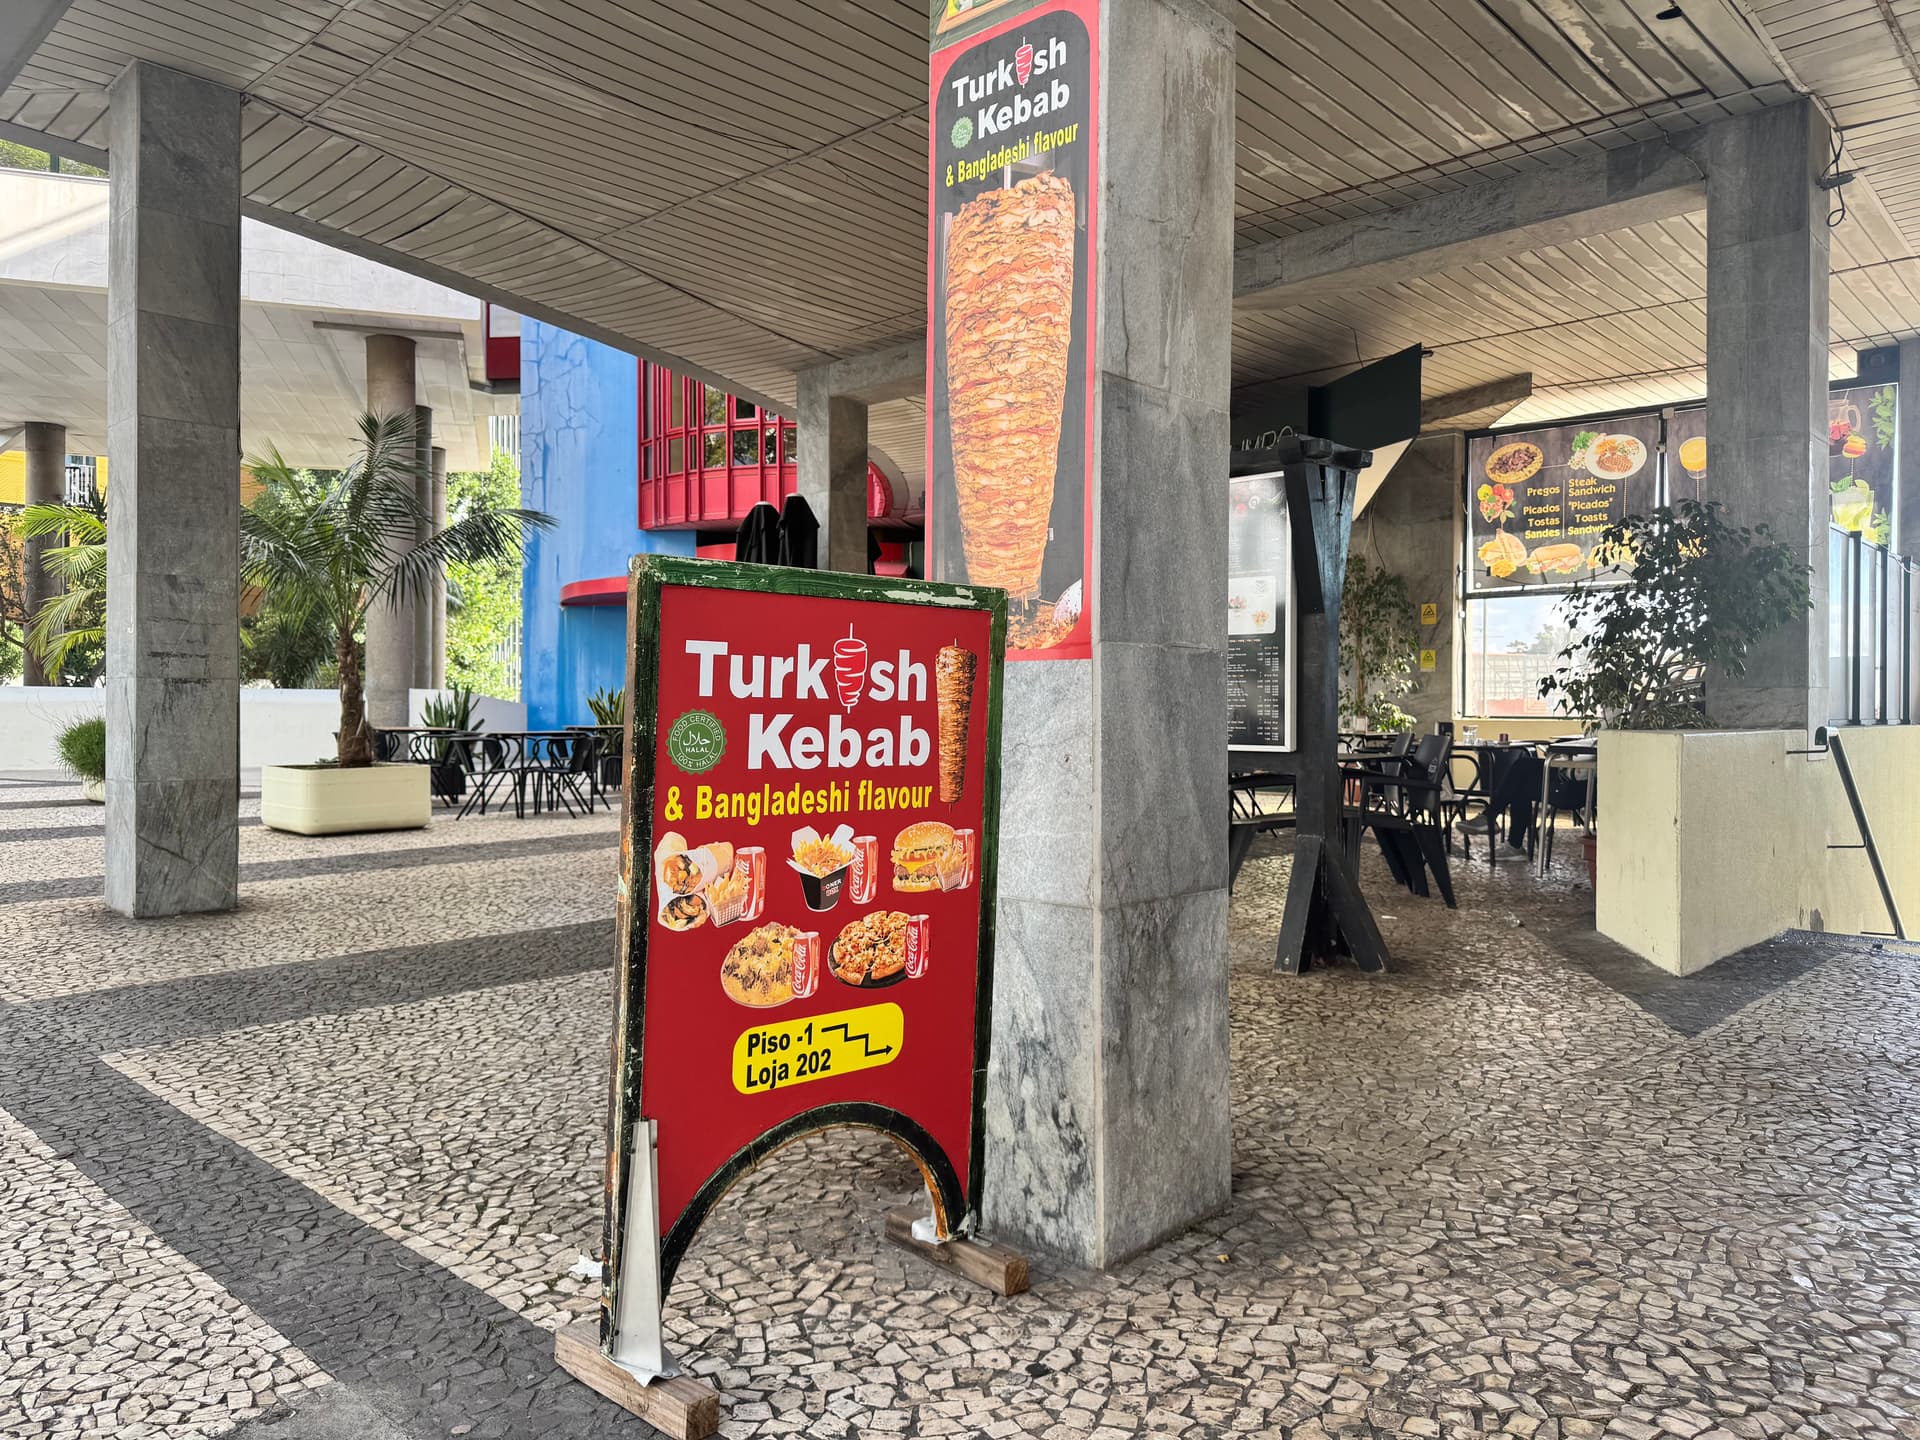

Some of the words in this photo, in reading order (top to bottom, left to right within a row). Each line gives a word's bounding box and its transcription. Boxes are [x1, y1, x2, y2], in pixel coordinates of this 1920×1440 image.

[978, 79, 1070, 139] Kebab
[945, 164, 954, 187] &
[957, 136, 1030, 182] Bangladeshi
[1034, 123, 1079, 155] flavour
[1526, 485, 1560, 497] Pregos
[1568, 477, 1597, 488] Steak
[1568, 484, 1616, 497] Sandwich
[1523, 504, 1560, 515] Picados
[1575, 512, 1608, 523] Toasts
[1527, 517, 1560, 527] Tostas
[1524, 529, 1561, 540] Sandes
[672, 720, 688, 741] FOOD
[690, 715, 721, 741] CERTIFIED
[747, 713, 931, 770] Kebab
[677, 752, 694, 768] 100%
[696, 751, 718, 768] HALAL
[664, 785, 684, 821] &
[695, 780, 850, 826] Bangladeshi
[858, 780, 933, 811] flavour
[747, 1031, 791, 1057] Piso
[797, 1022, 813, 1045] -1
[746, 1059, 789, 1089] Loja
[796, 1048, 832, 1077] 202
